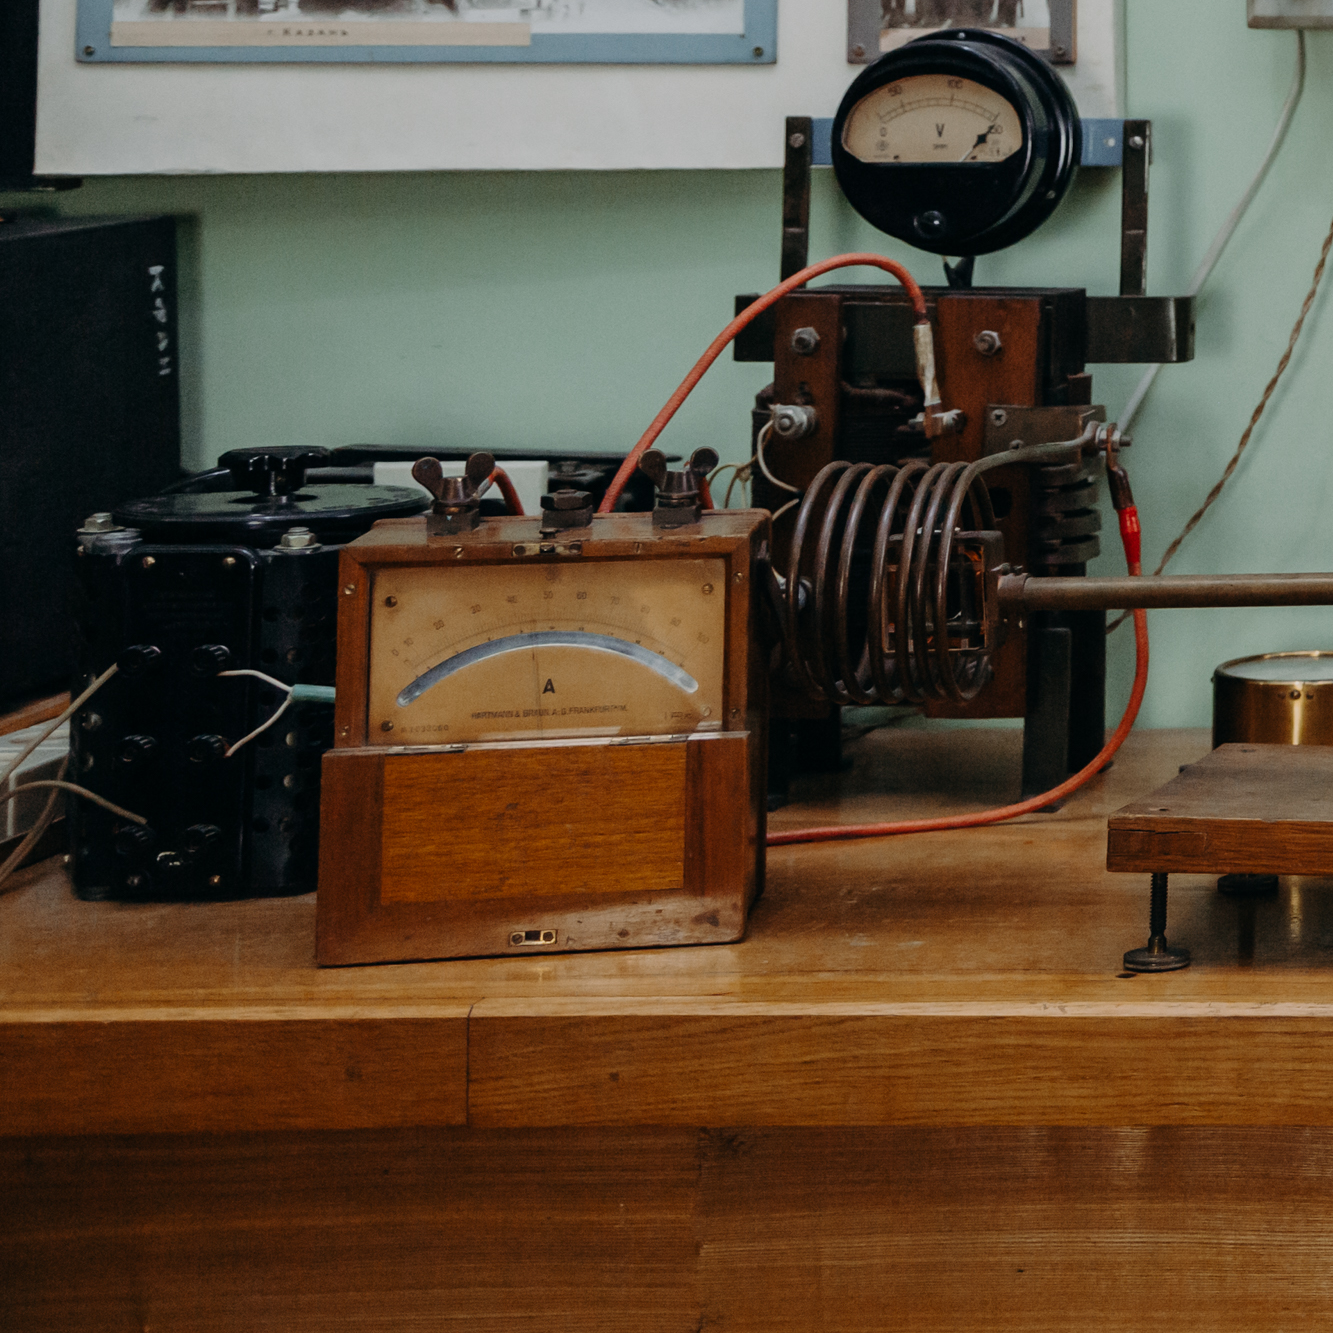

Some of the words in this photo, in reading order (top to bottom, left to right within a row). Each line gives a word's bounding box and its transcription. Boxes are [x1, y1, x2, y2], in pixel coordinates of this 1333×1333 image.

[935, 123, 945, 138] V
[543, 591, 554, 600] 50
[576, 591, 587, 600] 60
[542, 678, 555, 694] A
[471, 710, 514, 720] HARTMANN
[522, 708, 549, 718] BRAUN
